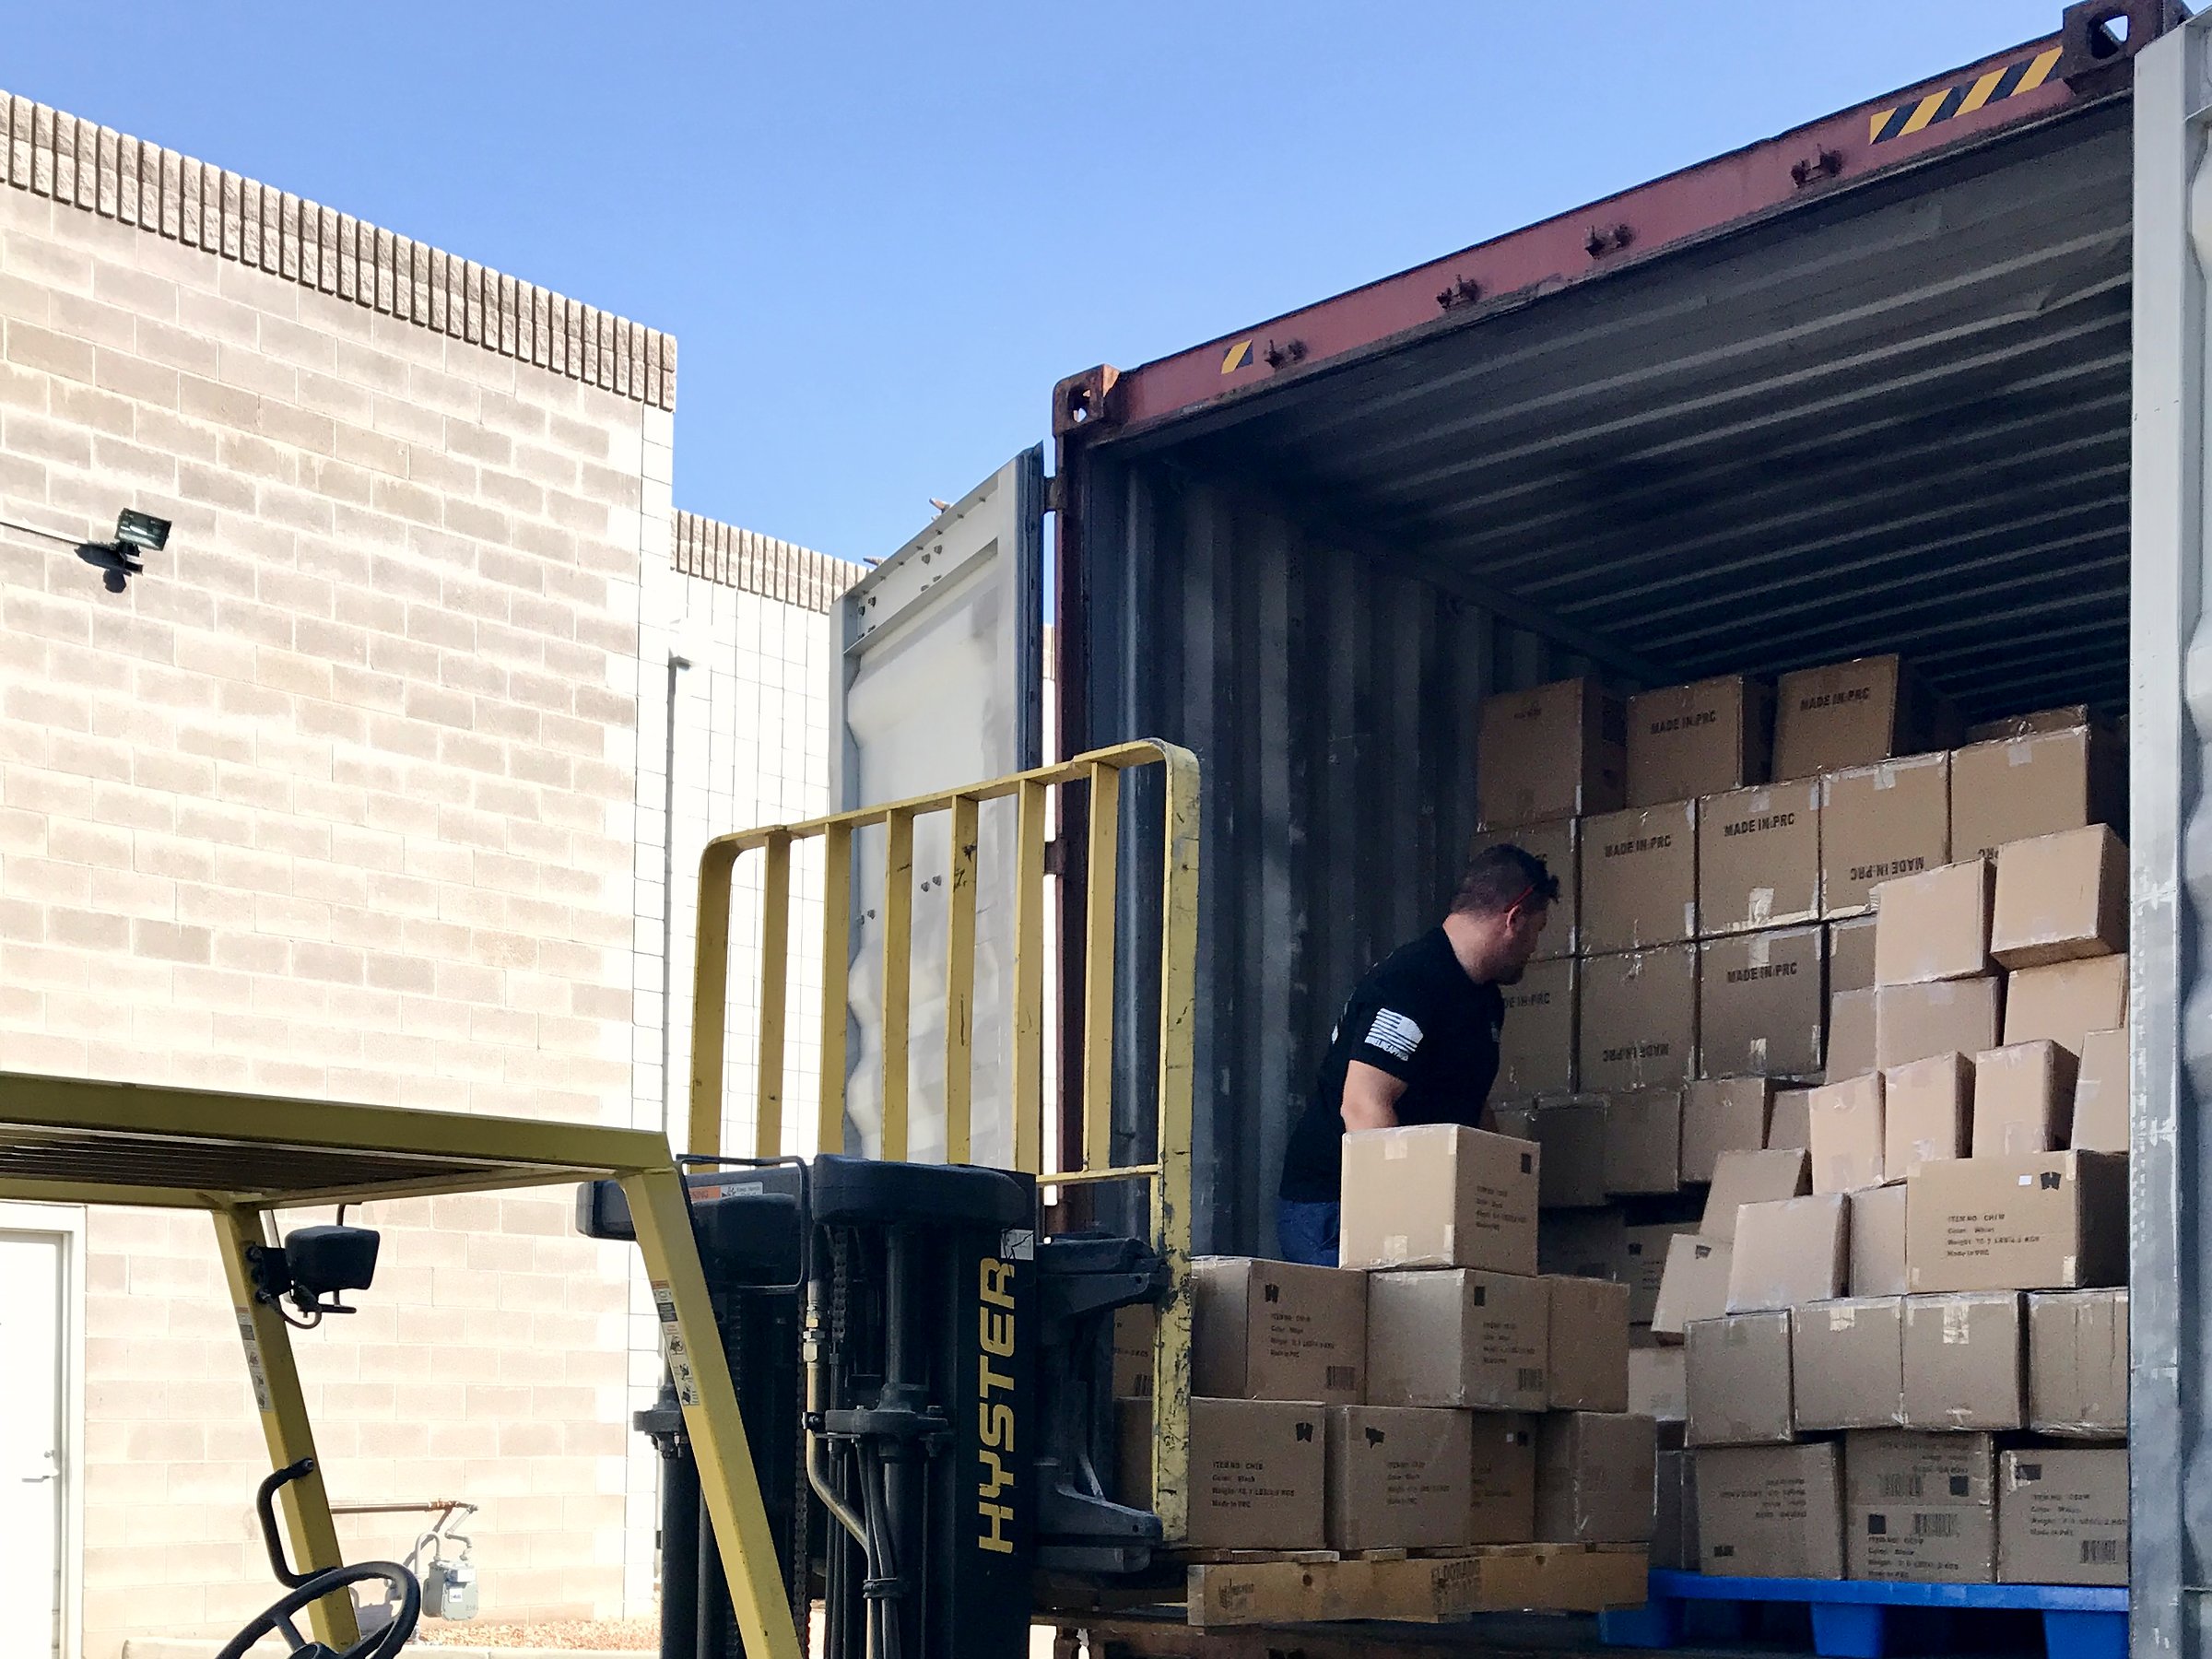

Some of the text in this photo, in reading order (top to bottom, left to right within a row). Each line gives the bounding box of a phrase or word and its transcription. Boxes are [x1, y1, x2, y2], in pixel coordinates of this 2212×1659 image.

[1651, 719, 1679, 734] MADE
[1724, 813, 1794, 837] MADE IN PRC
[1605, 835, 1671, 857] MADE IN PRC
[1851, 857, 1924, 880] MADE IN PRC
[1727, 962, 1797, 982] MADE IN PRC
[1531, 993, 1550, 1006] PRC
[979, 1258, 1015, 1553] HYSTER
